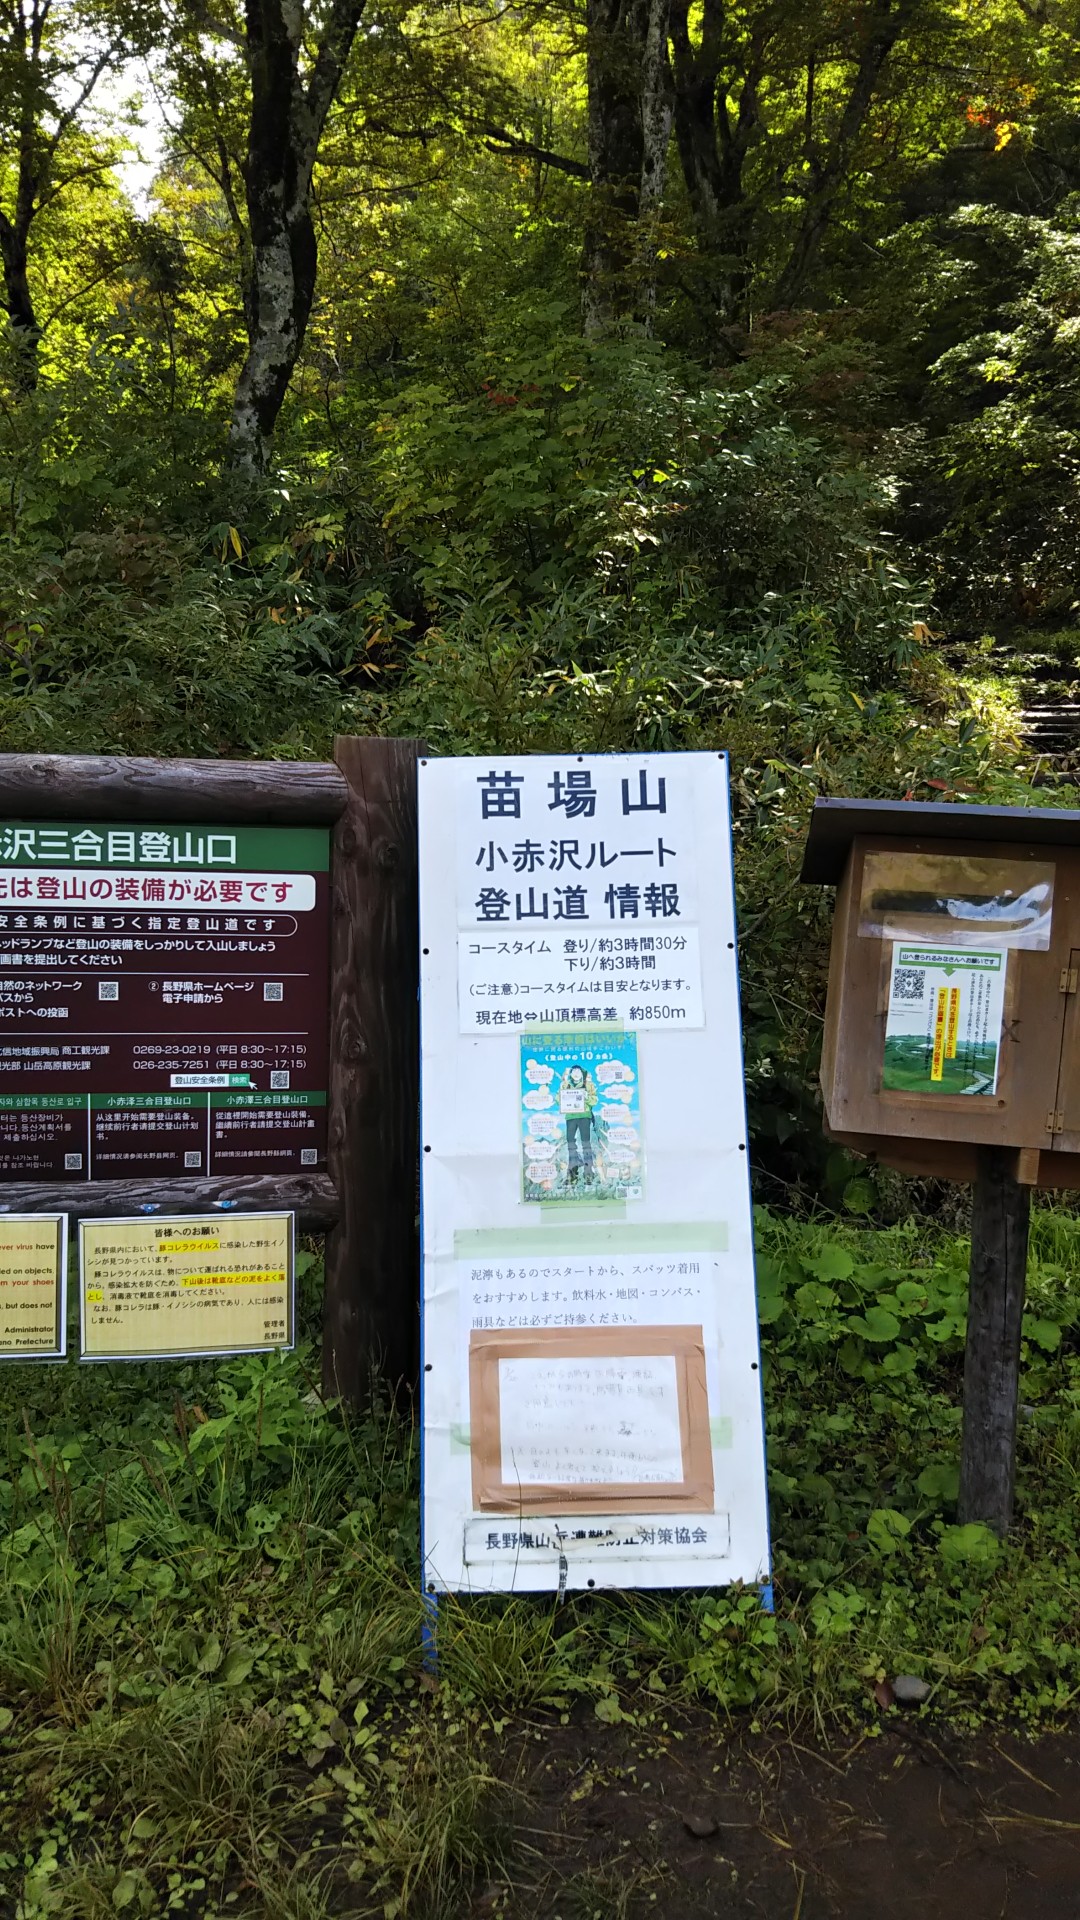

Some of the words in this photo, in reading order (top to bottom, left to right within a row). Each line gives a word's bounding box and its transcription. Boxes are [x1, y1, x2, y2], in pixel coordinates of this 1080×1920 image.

[476, 769, 667, 820] 苗場山
[0, 828, 236, 865] 沢三合目登山口
[475, 837, 677, 873] 小赤沢ルート
[475, 885, 590, 922] 登山道
[604, 882, 681, 919] 情報
[0, 938, 275, 952] ッドランプなど登山の装備をしっかりして入山しましょう
[468, 940, 551, 955] コースタイム
[563, 936, 688, 954] 登り/約3時間30分
[564, 955, 656, 972] 下り/約3時間
[162, 981, 255, 992] 長野県ホームページ
[162, 993, 224, 1004] 電子申請から
[629, 1006, 686, 1021] 約850m
[0, 1046, 60, 1056] 信地域振興局
[62, 1045, 111, 1055] 商工観光課
[133, 1045, 211, 1054] 0269-23-0219
[0, 1061, 21, 1071] 光部
[24, 1061, 91, 1071] 山岳高原観光課
[133, 1060, 210, 1069] 026-235-7251
[175, 1075, 226, 1085] 登山安全条例
[154, 1226, 220, 1238] 皆様へのお願い
[472, 1312, 638, 1329] 雨具などは必ずご持参ください。
[16, 1337, 54, 1345] Prefecture
